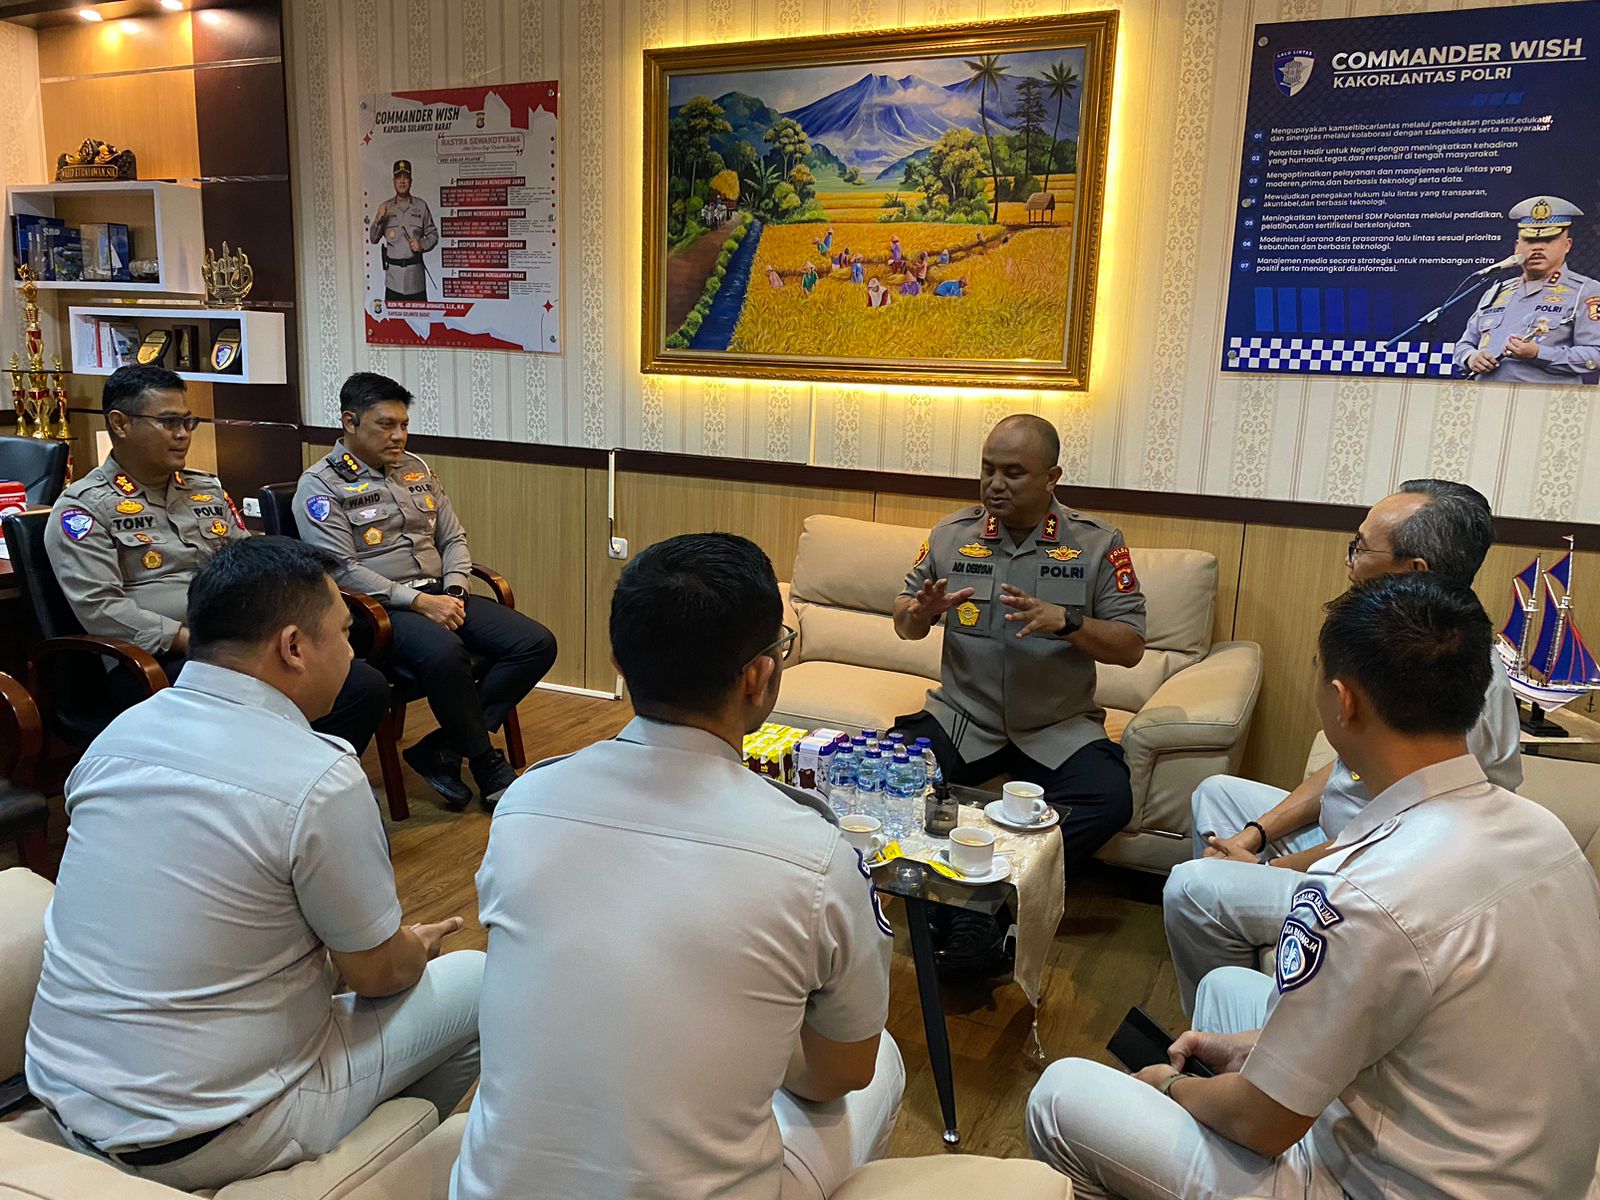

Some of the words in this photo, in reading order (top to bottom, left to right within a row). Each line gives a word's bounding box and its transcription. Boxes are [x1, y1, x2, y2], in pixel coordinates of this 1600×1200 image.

[1331, 43, 1501, 72] COMMANDER
[1510, 37, 1582, 60] WISH
[1333, 70, 1455, 89] KAKORLANTAS
[1460, 66, 1511, 82] POLRI
[375, 109, 433, 125] COMMANDER
[436, 107, 460, 121] WISH
[383, 125, 406, 134] KAPOLDA
[407, 123, 433, 132] SULAWESI
[434, 122, 452, 131] BARAT
[1271, 126, 1327, 135] Mengupayakan
[1329, 122, 1400, 132] kamseltibcarlantas
[1432, 119, 1480, 128] pendekatan
[1482, 115, 1553, 126] proaktif,edukatif,
[1286, 133, 1322, 142] sinergitas
[1351, 131, 1391, 139] kolaborasi
[1393, 129, 1423, 138] dengan
[1424, 127, 1476, 136] stakeholders
[1501, 125, 1550, 134] masyarakat
[1350, 146, 1376, 154] Negeri
[1378, 145, 1409, 154] dengan
[1411, 143, 1472, 152] meningkatkan
[1268, 158, 1288, 166] yang
[1366, 153, 1404, 162] responsif
[1404, 152, 1413, 160] di
[1414, 151, 1444, 161] tengah
[1445, 150, 1499, 159] masyarakat.
[1266, 171, 1331, 180] Mengoptimalkan
[1333, 169, 1376, 178] pelayanan
[1395, 166, 1445, 176] manajemen
[1464, 165, 1488, 173] lintas
[1490, 166, 1512, 174] yang
[1379, 177, 1417, 185] teknologi
[1264, 193, 1309, 201] Mewujudkan
[1311, 192, 1352, 200] penegakan
[1420, 190, 1440, 198] yang
[1441, 189, 1488, 197] transparan,
[1350, 197, 1387, 206] teknologi.
[1262, 214, 1316, 223] Meningkatkan
[1317, 213, 1364, 222] kompetensi
[1453, 211, 1504, 220] pendidikan,
[1354, 221, 1412, 229] berkelanjutan.
[1260, 235, 1305, 243] Modernisasi
[1465, 234, 1502, 243] prioritas
[1352, 243, 1391, 251] teknologi.
[1257, 257, 1302, 266] Manajemen
[1357, 257, 1392, 265] strategis
[1419, 257, 1473, 265] membangun
[1256, 265, 1279, 273] positif
[1301, 265, 1345, 273] menangkal
[1534, 305, 1563, 313] POLRI
[349, 493, 381, 508] WAHID
[113, 515, 154, 531] TONY
[1109, 547, 1128, 560] POLDA
[952, 561, 965, 573] ADI
[1040, 565, 1084, 579] POLRI
[1294, 927, 1318, 953] RAHARJA
